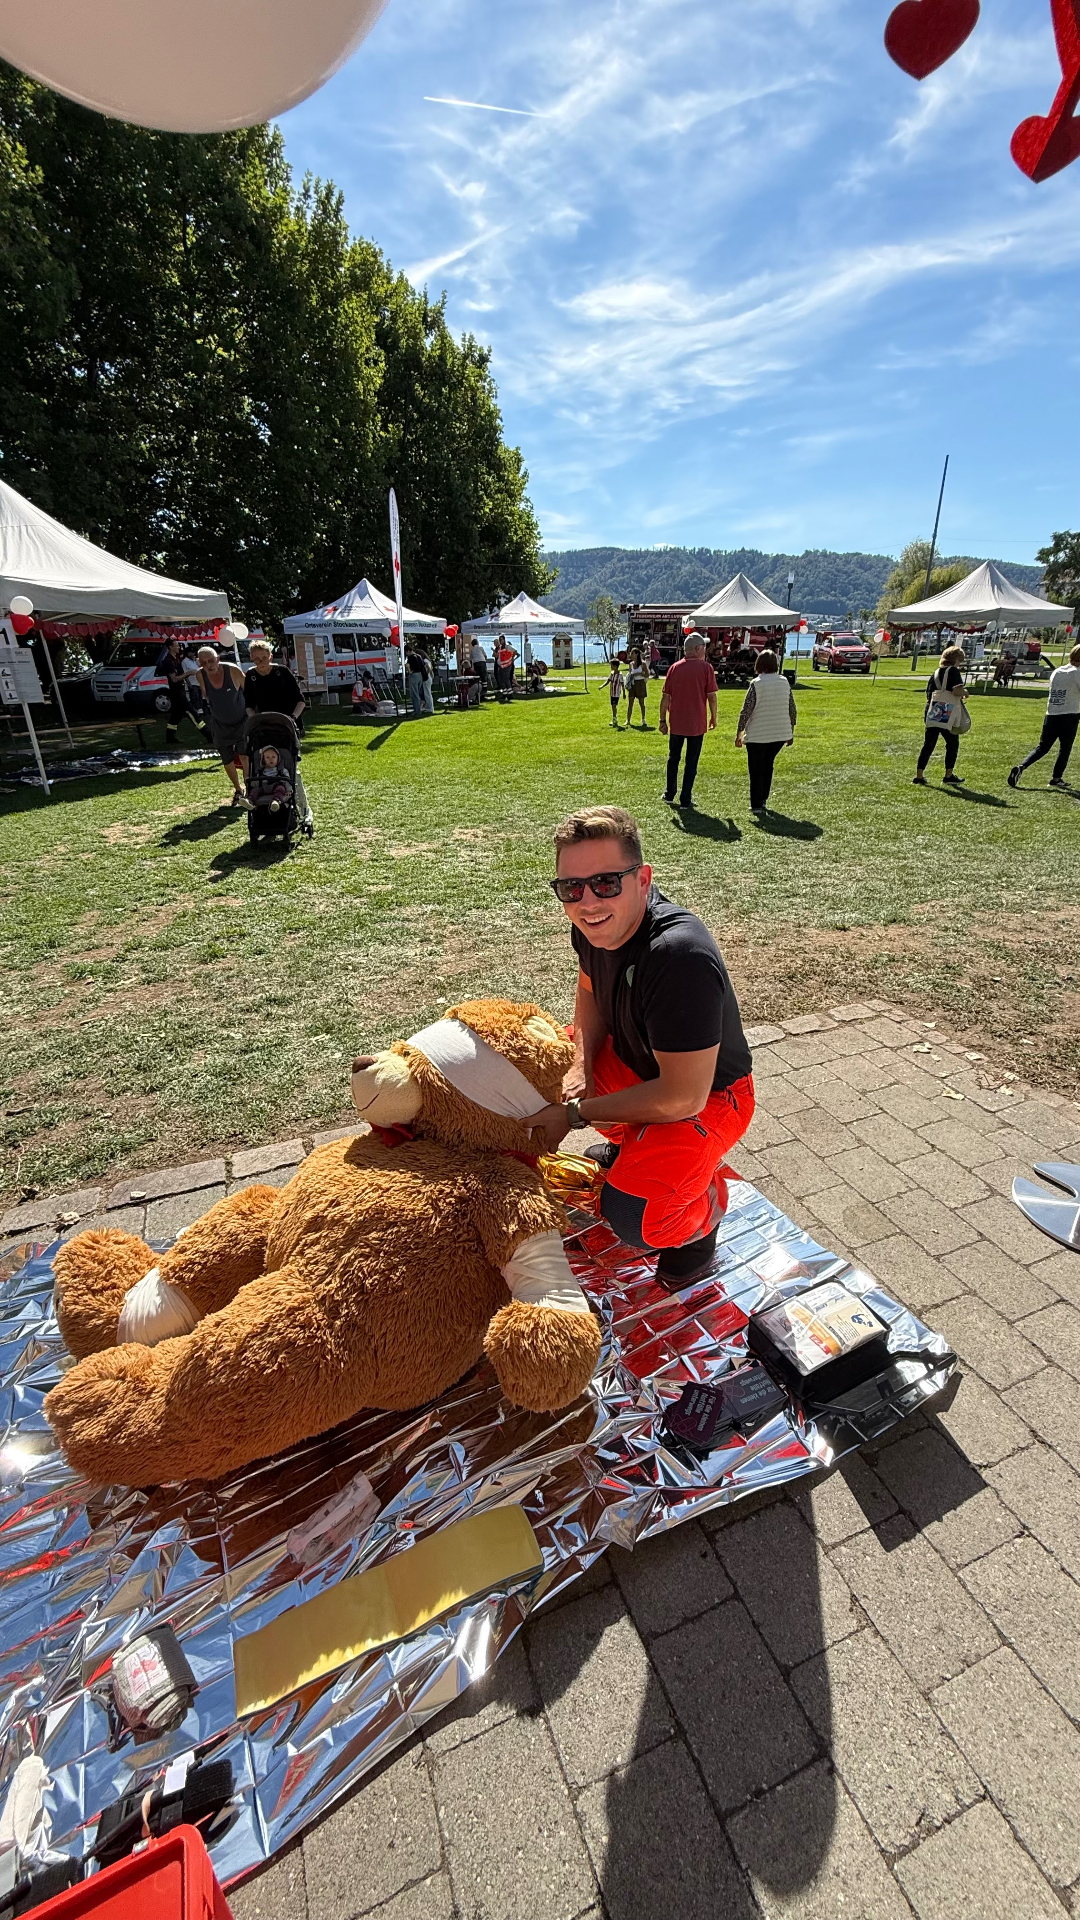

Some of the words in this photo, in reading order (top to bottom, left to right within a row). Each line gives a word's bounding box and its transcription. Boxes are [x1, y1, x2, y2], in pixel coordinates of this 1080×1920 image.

[304, 621, 333, 629] Ortsverein
[333, 620, 359, 628] Stockach
[739, 1372, 766, 1387] unterwegs
[750, 1379, 773, 1391] Notfälle
[758, 1389, 767, 1397] die
[767, 1385, 777, 1394] Für
[684, 1389, 700, 1416] unterwegs
[694, 1392, 708, 1414] Notfälle
[707, 1395, 717, 1404] Für
[740, 1392, 759, 1404] kleinen
[704, 1404, 713, 1413] die
[696, 1413, 710, 1432] kleinen
